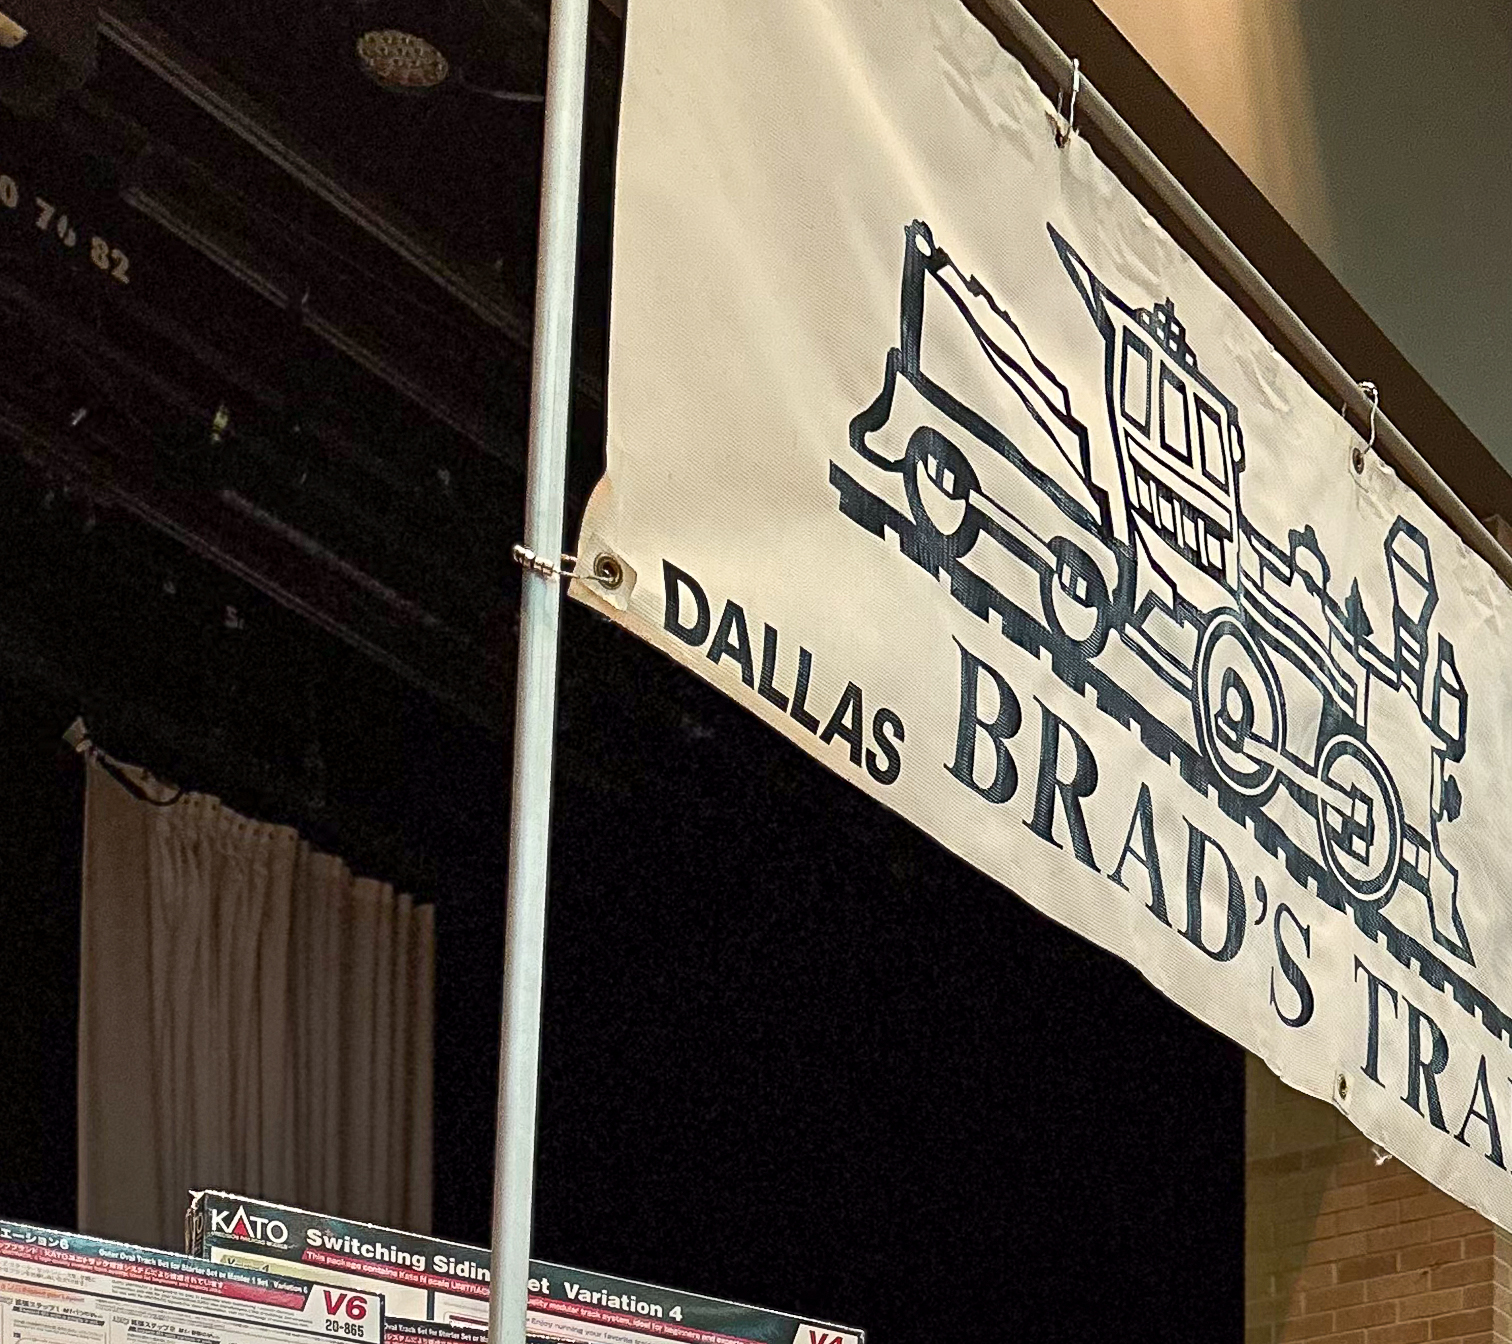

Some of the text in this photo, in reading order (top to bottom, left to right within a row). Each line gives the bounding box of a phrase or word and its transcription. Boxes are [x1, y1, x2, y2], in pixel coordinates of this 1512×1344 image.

[661, 559, 907, 787] DALLAS
[943, 635, 1312, 1027] BRAD'S
[211, 1205, 288, 1244] KATO
[98, 1248, 302, 1293] Outer Oval Track Set Starter Set Master Set Variation
[306, 1228, 684, 1321] Switching Sidin et Variation 4
[306, 1251, 327, 1263] This
[327, 1255, 361, 1271] package
[362, 1263, 398, 1279] contains
[428, 1276, 449, 1289] scale
[549, 1302, 578, 1317] modular
[580, 1307, 601, 1321] track
[650, 1321, 662, 1332] for
[664, 1325, 700, 1343] beginners
[701, 1332, 715, 1344] and
[323, 1289, 368, 1320] V6
[325, 1318, 364, 1338] 20-865
[531, 1317, 553, 1331] Enjoy
[554, 1322, 584, 1337] running
[584, 1329, 602, 1339] your
[604, 1331, 633, 1344] favorite
